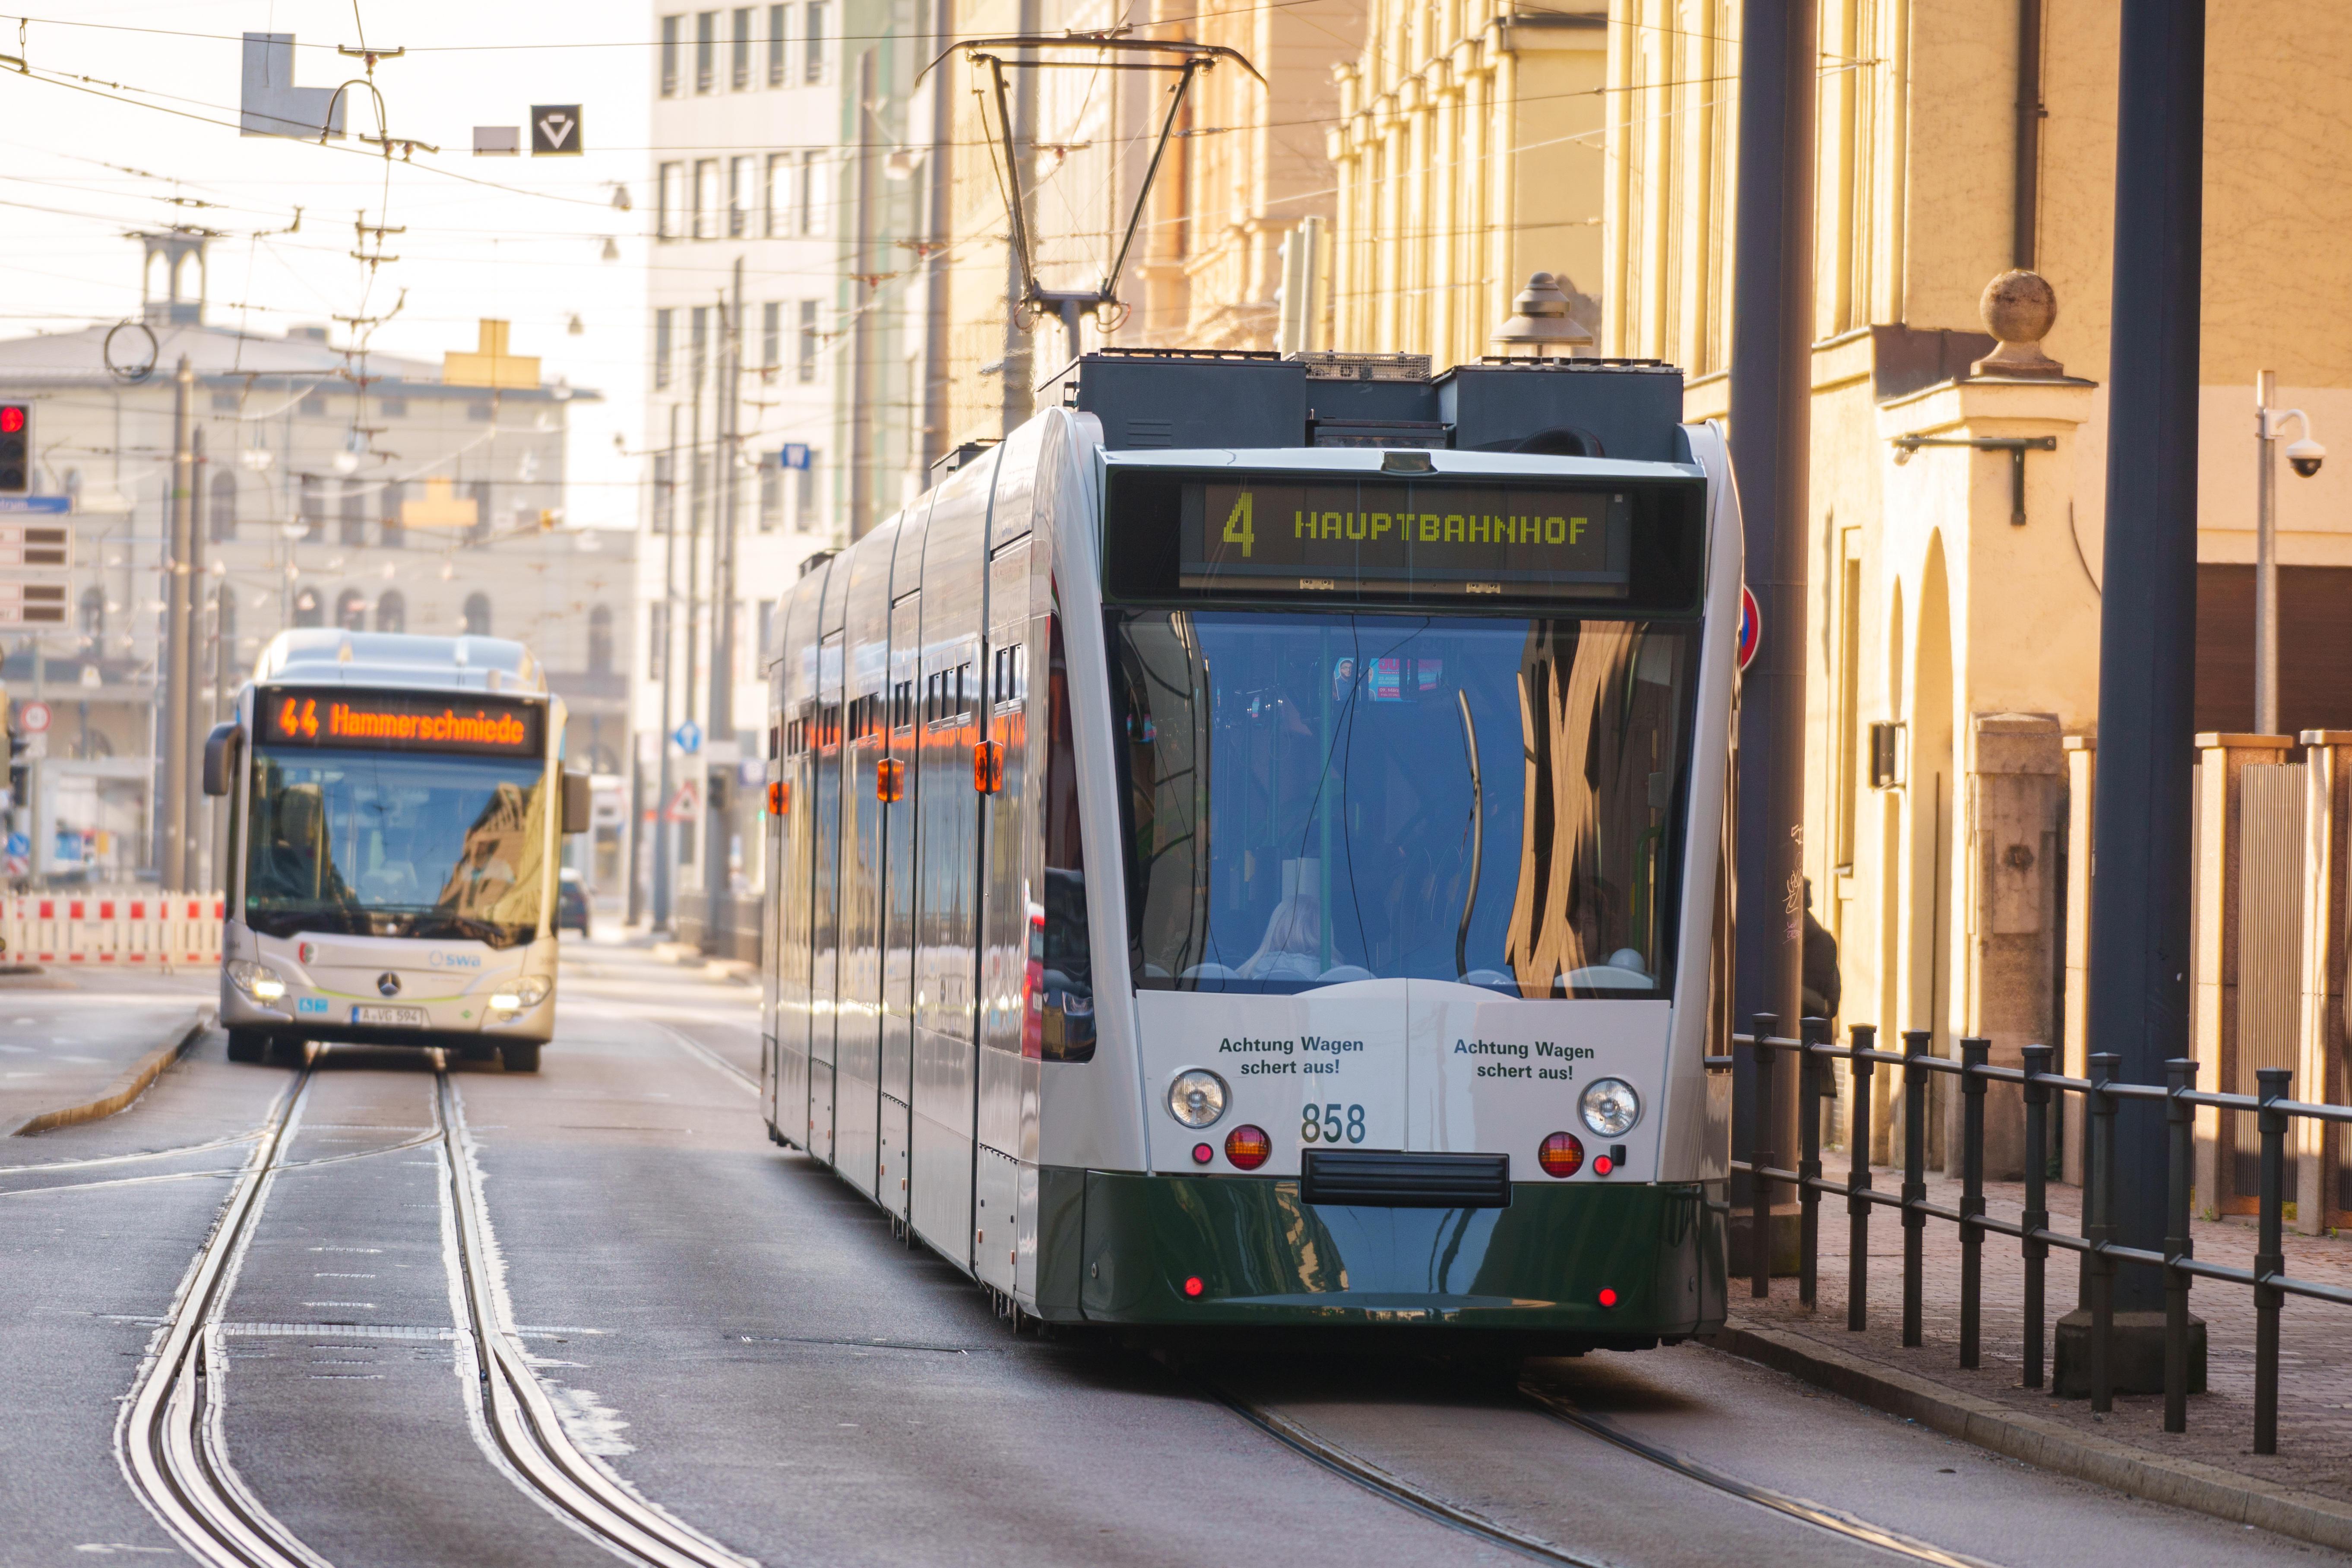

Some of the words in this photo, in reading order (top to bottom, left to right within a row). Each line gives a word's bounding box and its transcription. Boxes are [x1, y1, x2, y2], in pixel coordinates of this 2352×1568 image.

[1223, 492, 1254, 557] 4
[1295, 511, 1588, 545] HAUPTBAHNHOF
[280, 698, 319, 737] 44
[330, 703, 524, 744] Hammerschmiede
[397, 1010, 418, 1021] 594
[1219, 1037, 1294, 1055] Achtung
[1301, 1036, 1364, 1055] Wagen
[1453, 1039, 1529, 1058] Achtung
[1535, 1041, 1595, 1061] Wagen
[1241, 1059, 1297, 1074] schert
[1303, 1059, 1339, 1074] aus!
[1477, 1063, 1532, 1079] schert
[1538, 1065, 1573, 1080] aus!
[1301, 1103, 1366, 1144] 858
